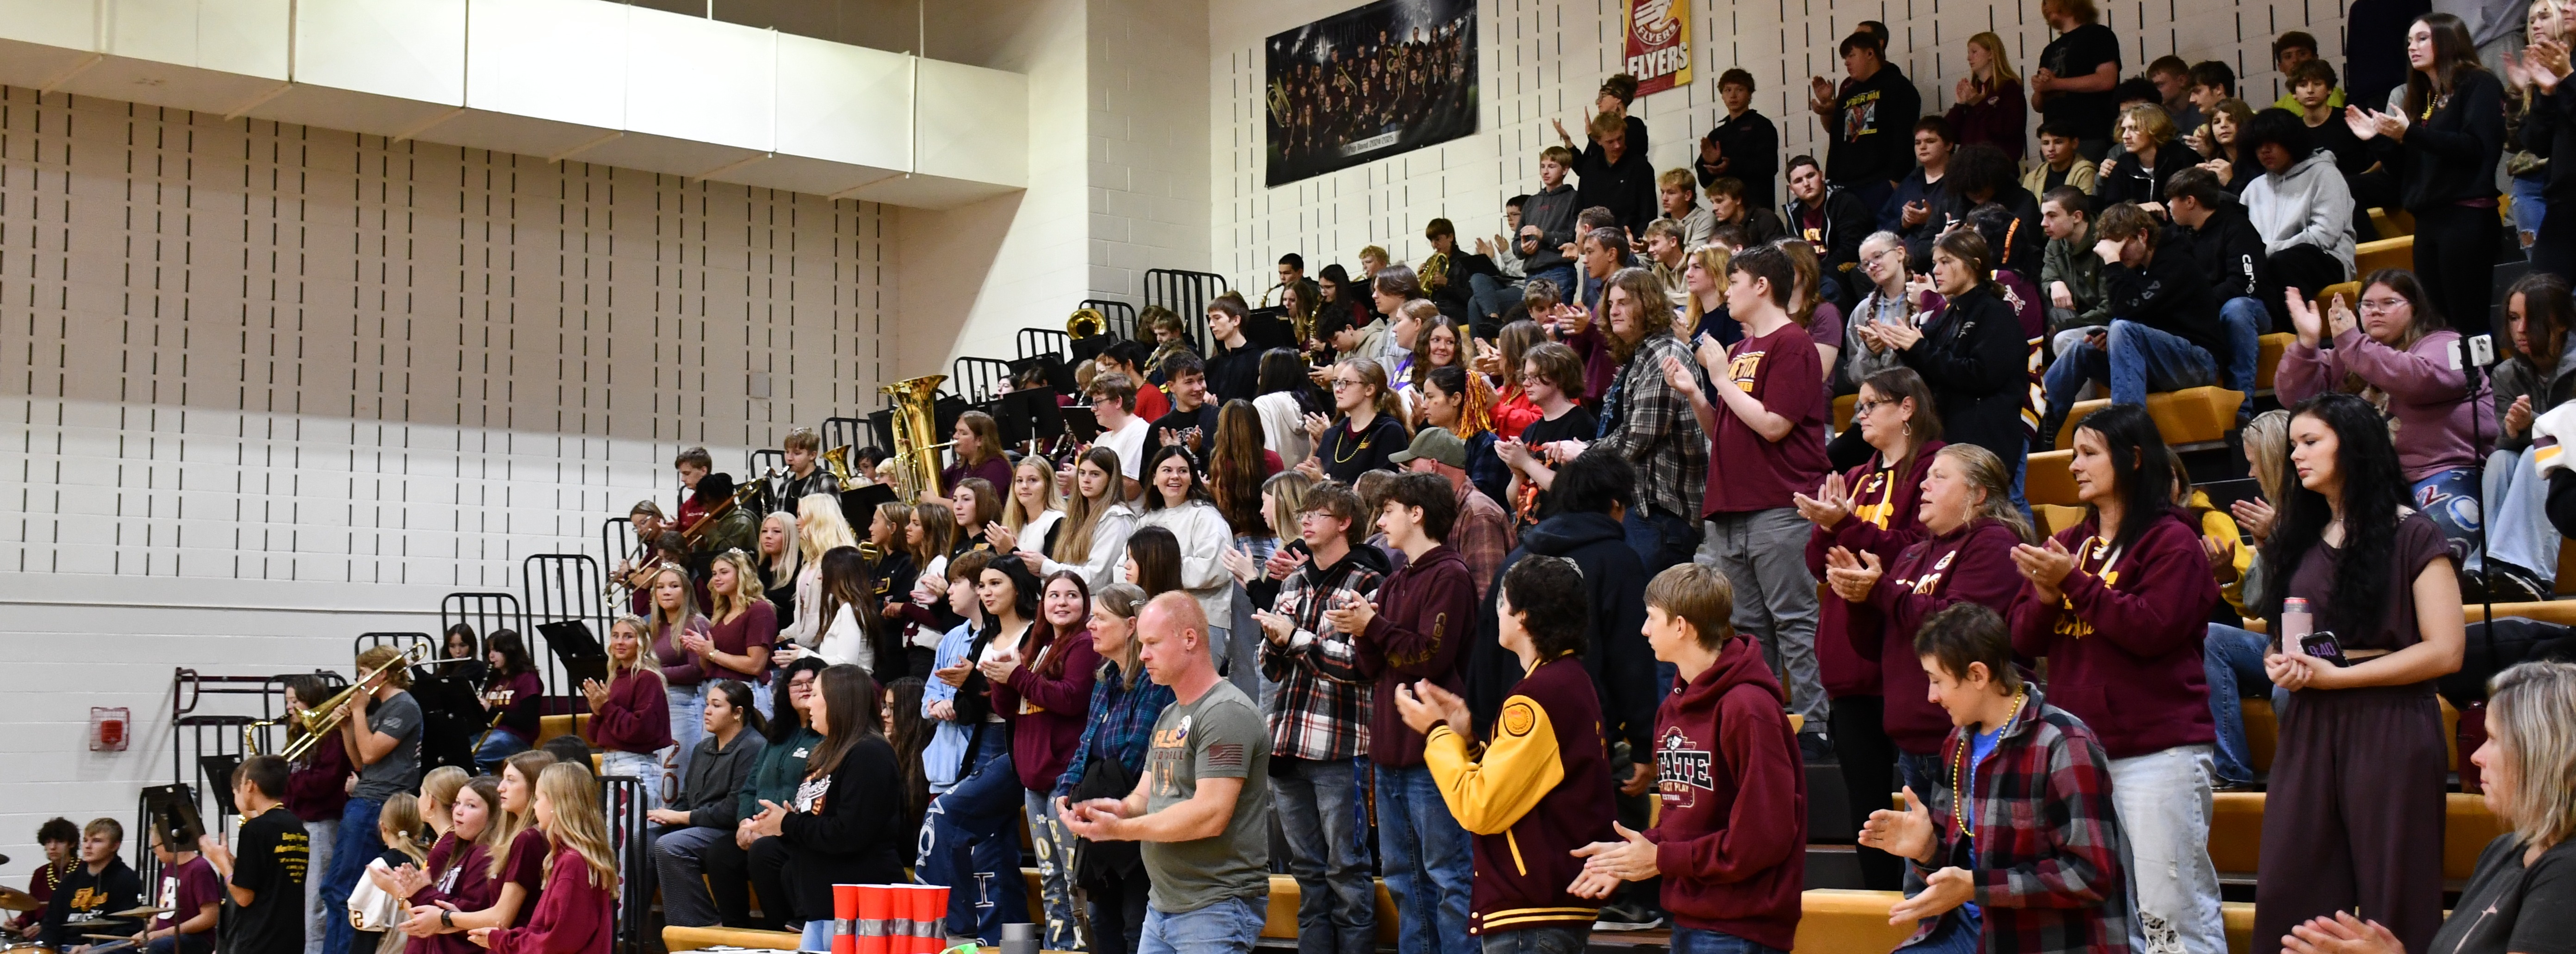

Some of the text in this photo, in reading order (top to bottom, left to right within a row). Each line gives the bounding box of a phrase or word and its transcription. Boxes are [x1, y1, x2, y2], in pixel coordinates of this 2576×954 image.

[1638, 24, 1676, 42] FLYERS
[1627, 41, 1689, 81] FLYERS
[1357, 142, 1368, 150] Band
[2308, 642, 2336, 658] 9:40
[1656, 750, 1714, 792] TATE
[1674, 784, 1689, 793] PLAY
